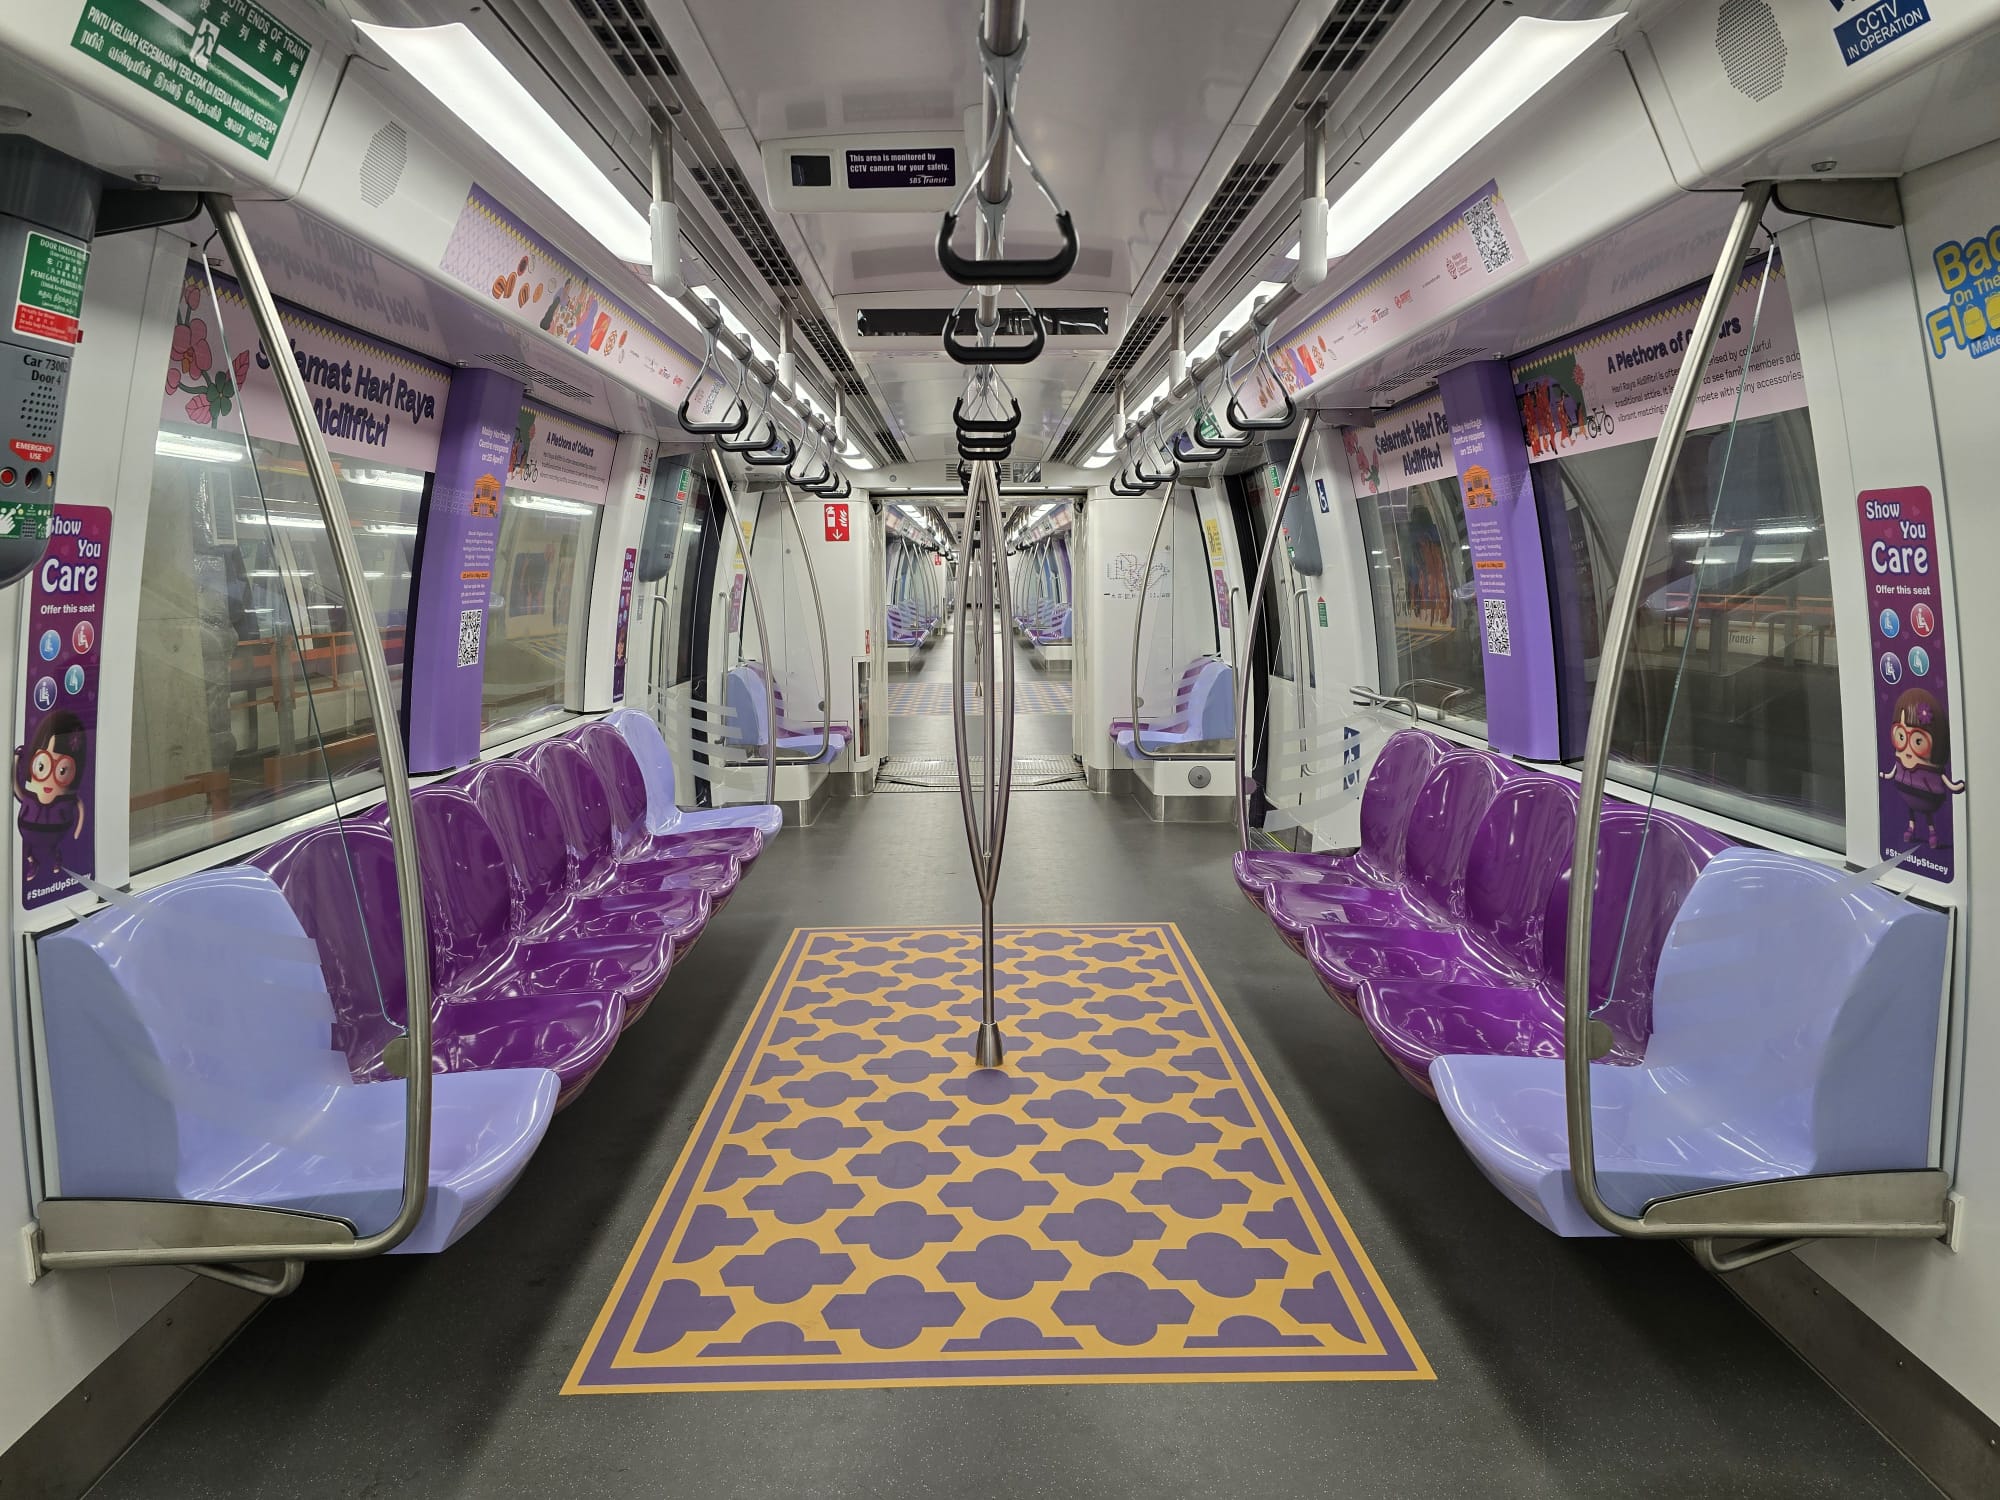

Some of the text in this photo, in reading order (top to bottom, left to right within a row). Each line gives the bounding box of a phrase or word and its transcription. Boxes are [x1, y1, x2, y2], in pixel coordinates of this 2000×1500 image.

[1856, 0, 1898, 36] CCTV
[222, 0, 306, 61] OTH ENDS OF TRAIN
[1847, 8, 1924, 59] IN OPERATION
[87, 6, 111, 30] PINTU
[108, 19, 139, 48] KELUAR
[136, 37, 178, 72] KECEMASAN
[176, 62, 208, 91] TERLETAK
[205, 82, 215, 96] DI
[212, 84, 233, 109] KEDUA
[849, 153, 936, 162] This area is monitored by
[850, 165, 867, 173] CCTV
[869, 164, 895, 172] camera
[909, 164, 924, 172] your
[926, 163, 950, 172] safety.
[916, 175, 947, 184] Transit
[40, 239, 59, 252] DOOR
[1953, 274, 2000, 306] On The
[23, 354, 43, 368] Car
[1606, 356, 1617, 375] A
[1615, 342, 1669, 371] Plethora
[1669, 330, 1684, 354] of
[1729, 351, 1738, 361] by
[1711, 372, 1725, 383] see
[1747, 355, 1785, 372] members
[1785, 351, 1801, 363] ado
[31, 369, 55, 385] Door
[256, 337, 435, 424] Samat Hari Raya
[1696, 391, 1719, 402] mplete
[1720, 386, 1735, 398] with
[1735, 381, 1755, 394] siny
[1756, 370, 1804, 389] accessories.
[546, 431, 551, 445] A
[551, 432, 571, 451] Plethora
[1375, 411, 1449, 456] Selamat Hari Ra
[15, 441, 52, 453] EMERGENCY
[29, 452, 42, 461] USE
[1865, 501, 1900, 519] Show
[1900, 521, 1926, 539] You
[78, 539, 101, 557] You
[1871, 541, 1929, 574] Care
[41, 558, 98, 593] Care
[1875, 584, 1932, 596] Offer this seat
[40, 603, 96, 615] Offer this seat
[1885, 847, 1949, 876] #StdUpStacey
